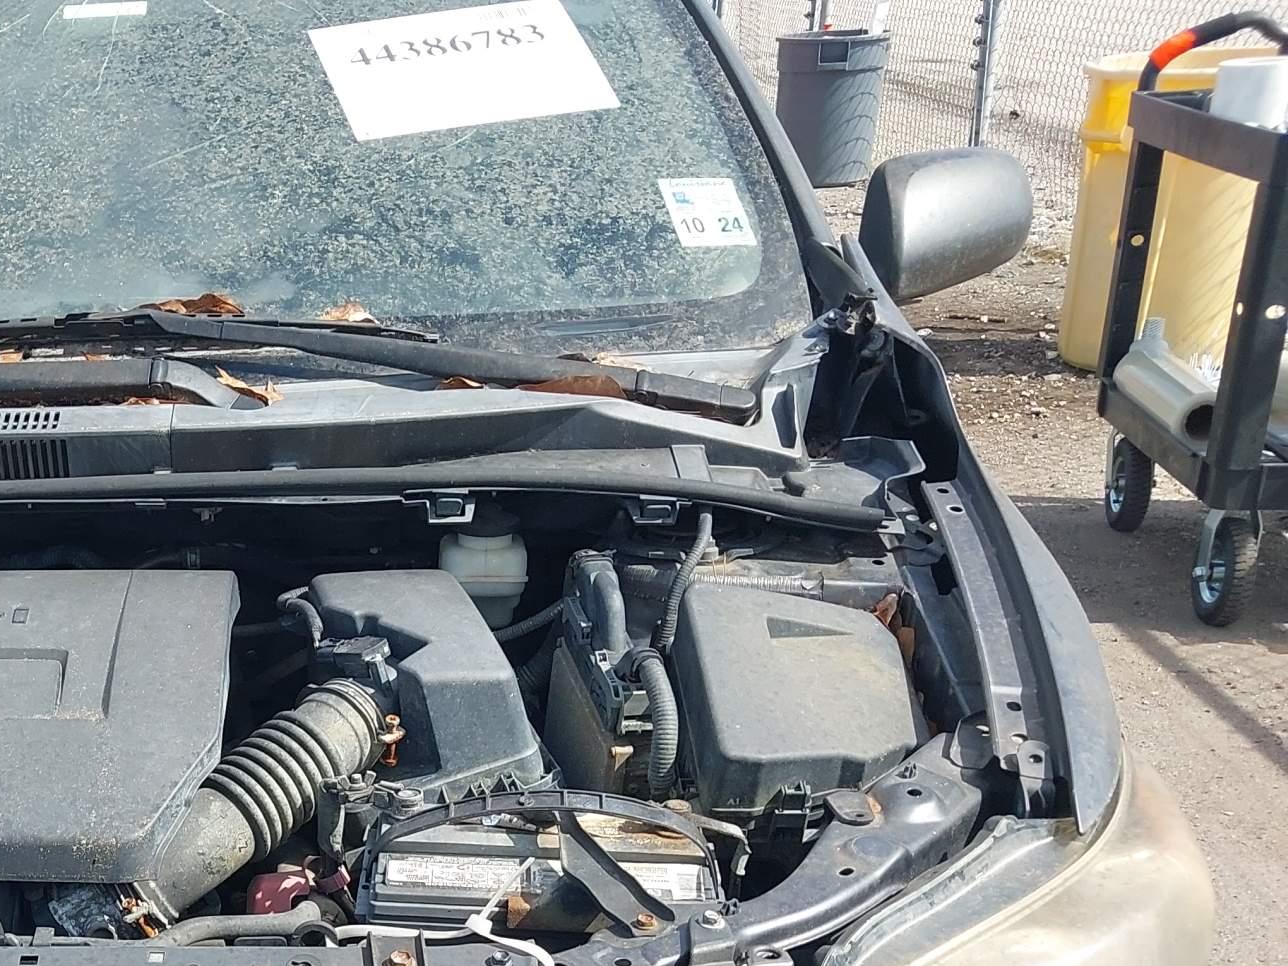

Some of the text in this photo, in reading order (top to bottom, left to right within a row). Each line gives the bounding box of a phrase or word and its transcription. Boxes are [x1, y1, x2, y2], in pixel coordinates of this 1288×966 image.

[350, 24, 545, 65] 44386783
[680, 217, 744, 233] 10 24
